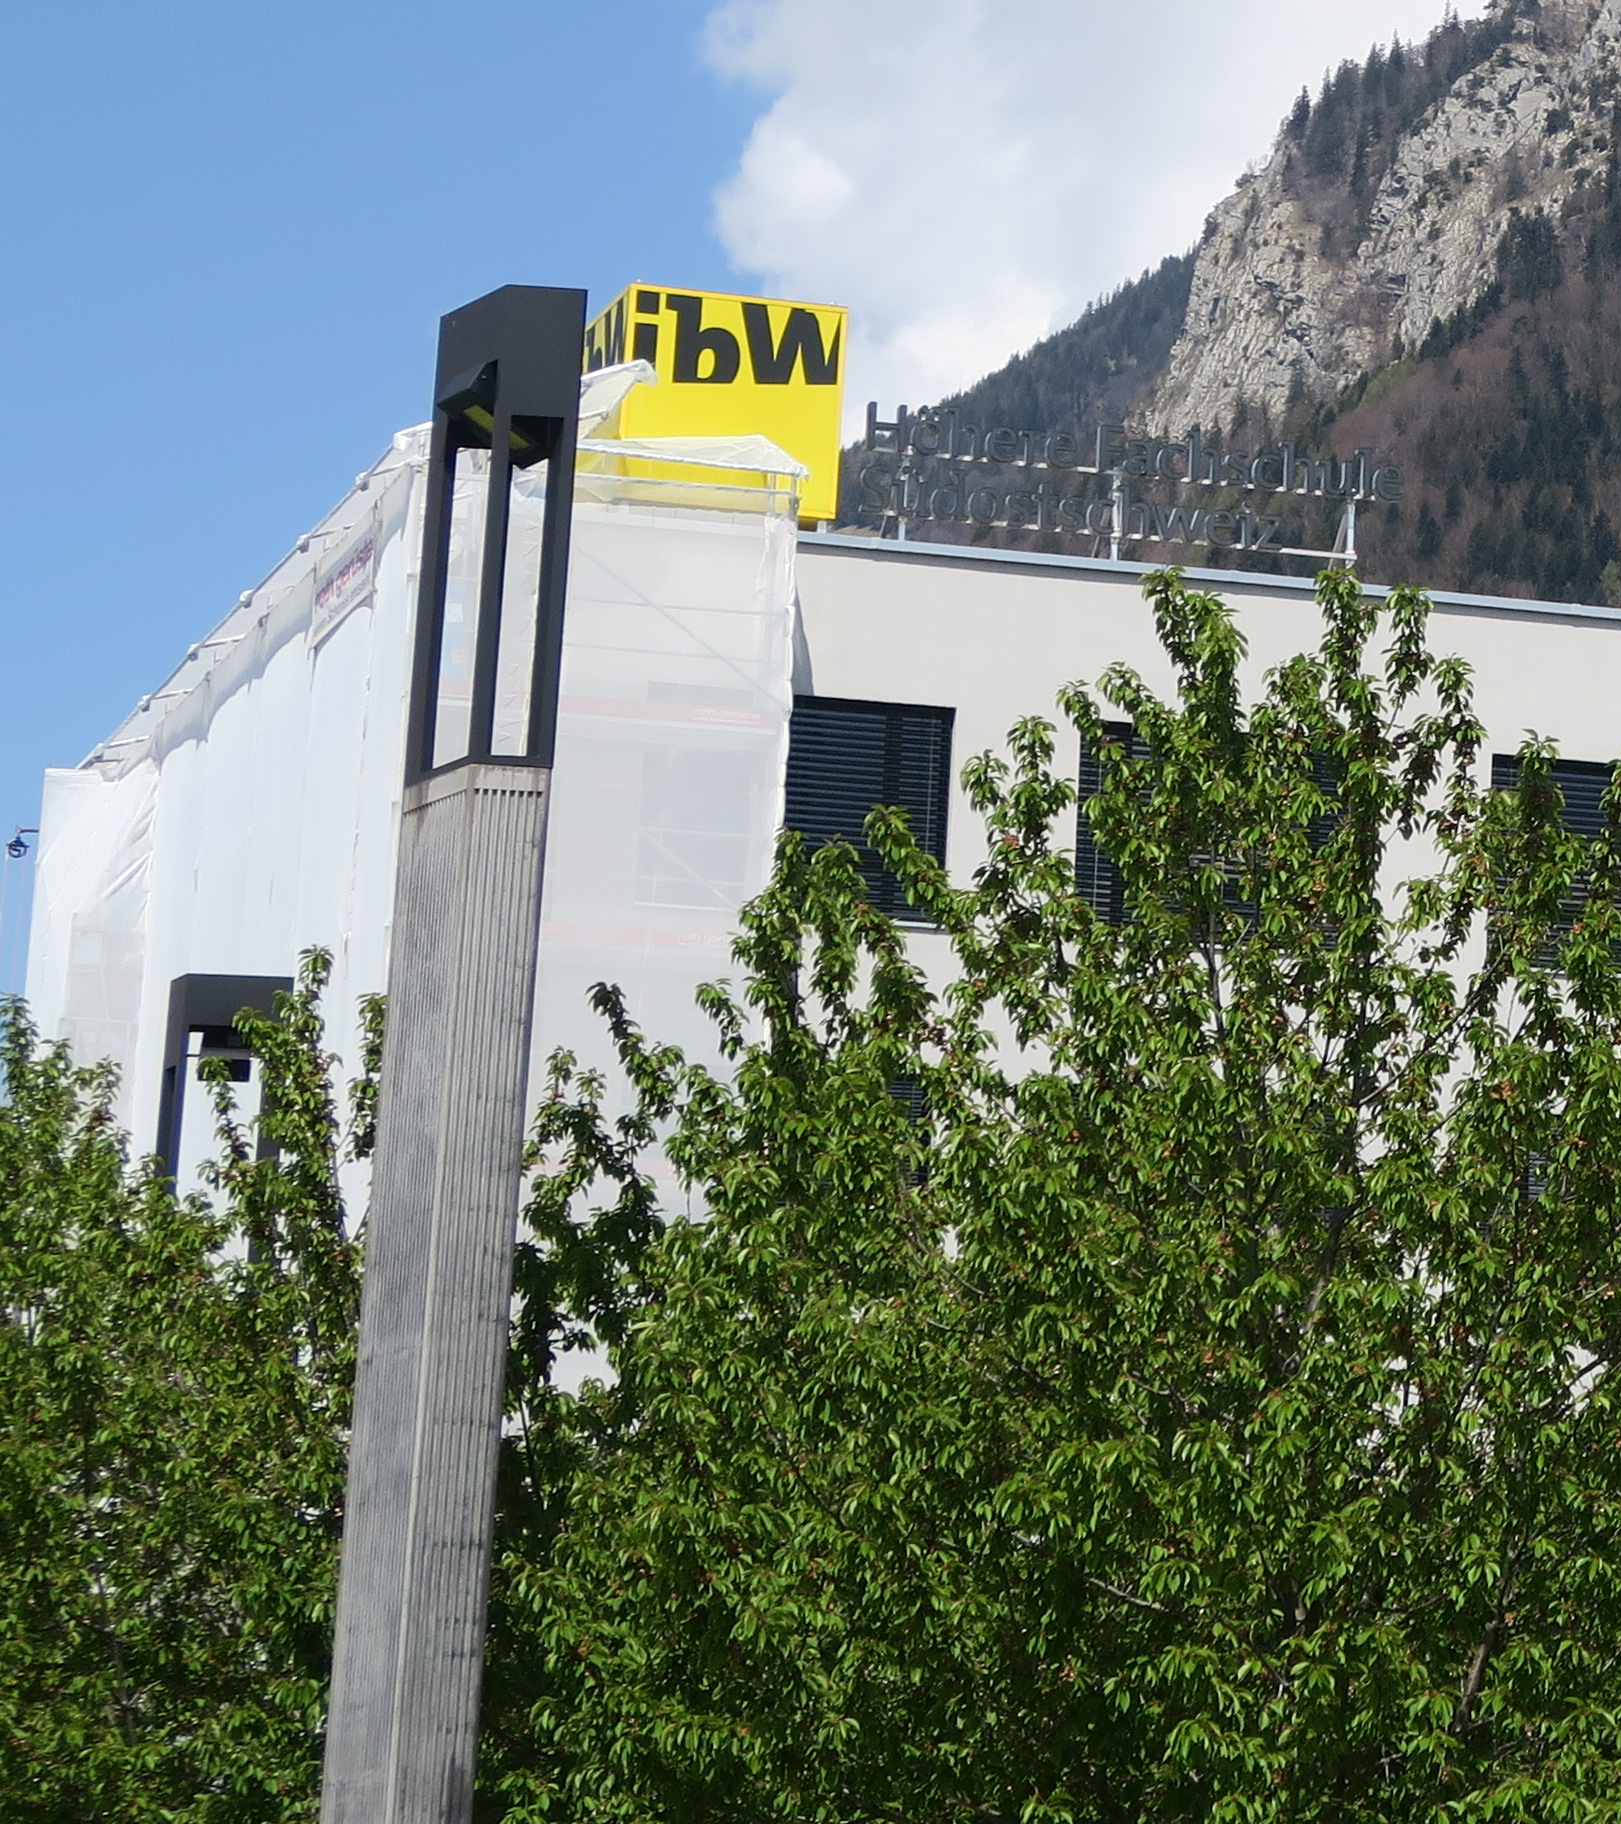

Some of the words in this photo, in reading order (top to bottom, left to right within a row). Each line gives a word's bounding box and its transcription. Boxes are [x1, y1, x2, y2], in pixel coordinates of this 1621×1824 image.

[633, 289, 841, 386] ibW
[866, 400, 1078, 469] Höhere
[1096, 424, 1405, 502] Fachschule
[858, 463, 1283, 551] Südostschweiz
